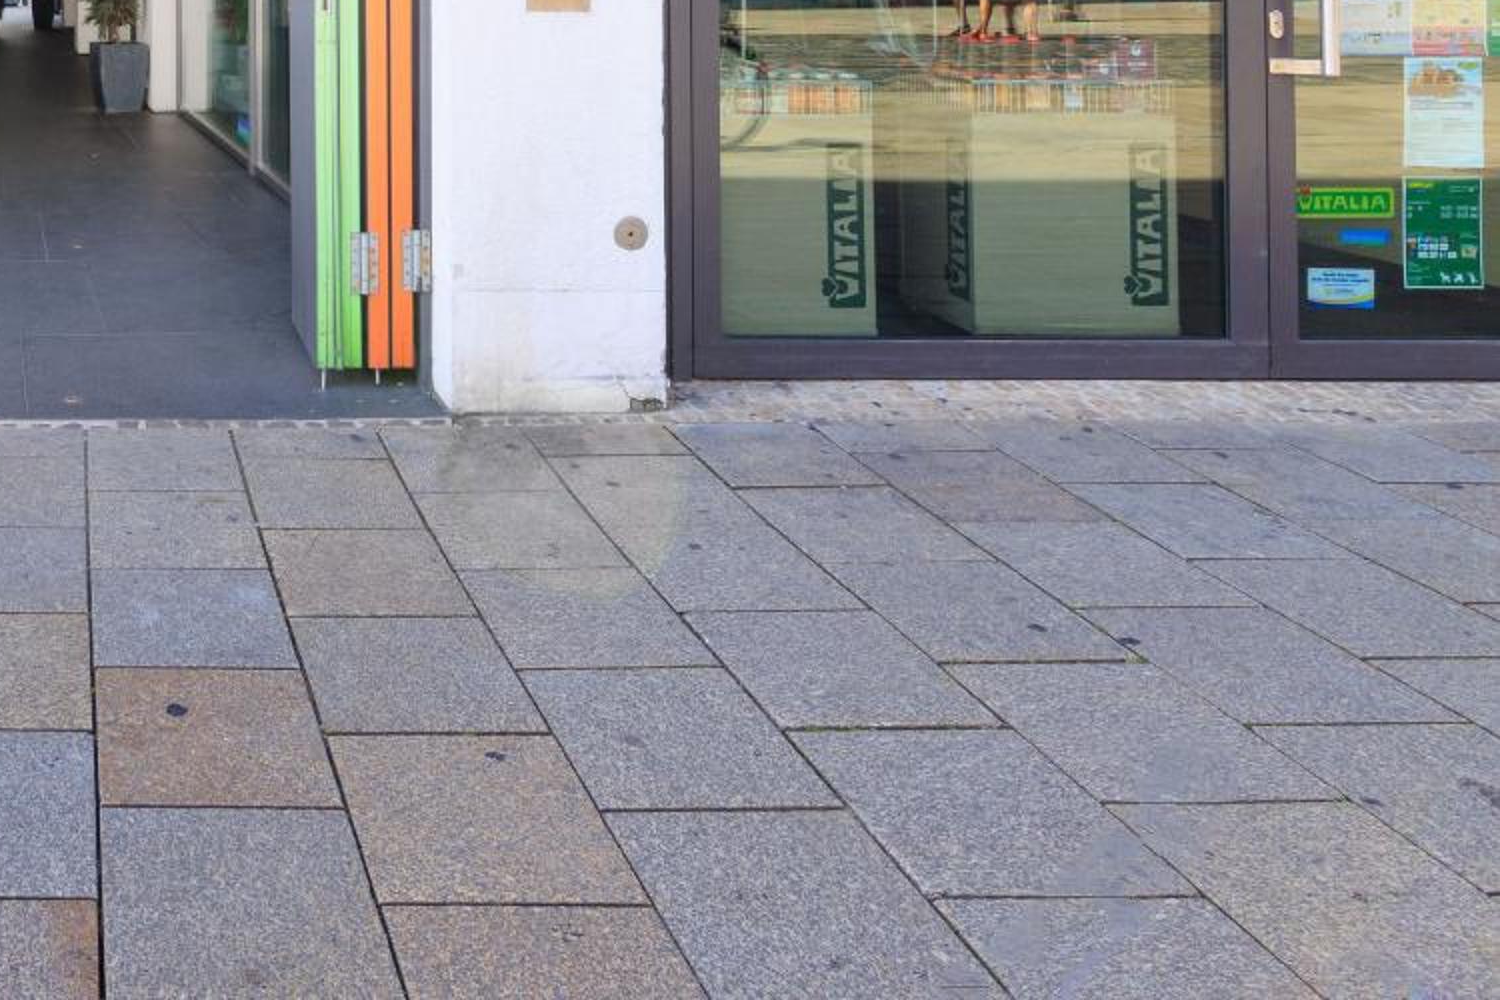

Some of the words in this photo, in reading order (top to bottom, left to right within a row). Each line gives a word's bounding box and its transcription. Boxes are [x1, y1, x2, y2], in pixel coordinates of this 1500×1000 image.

[832, 148, 860, 302] VITALIA
[1136, 149, 1162, 300] VITALIA
[1298, 194, 1388, 212] VITALIA
